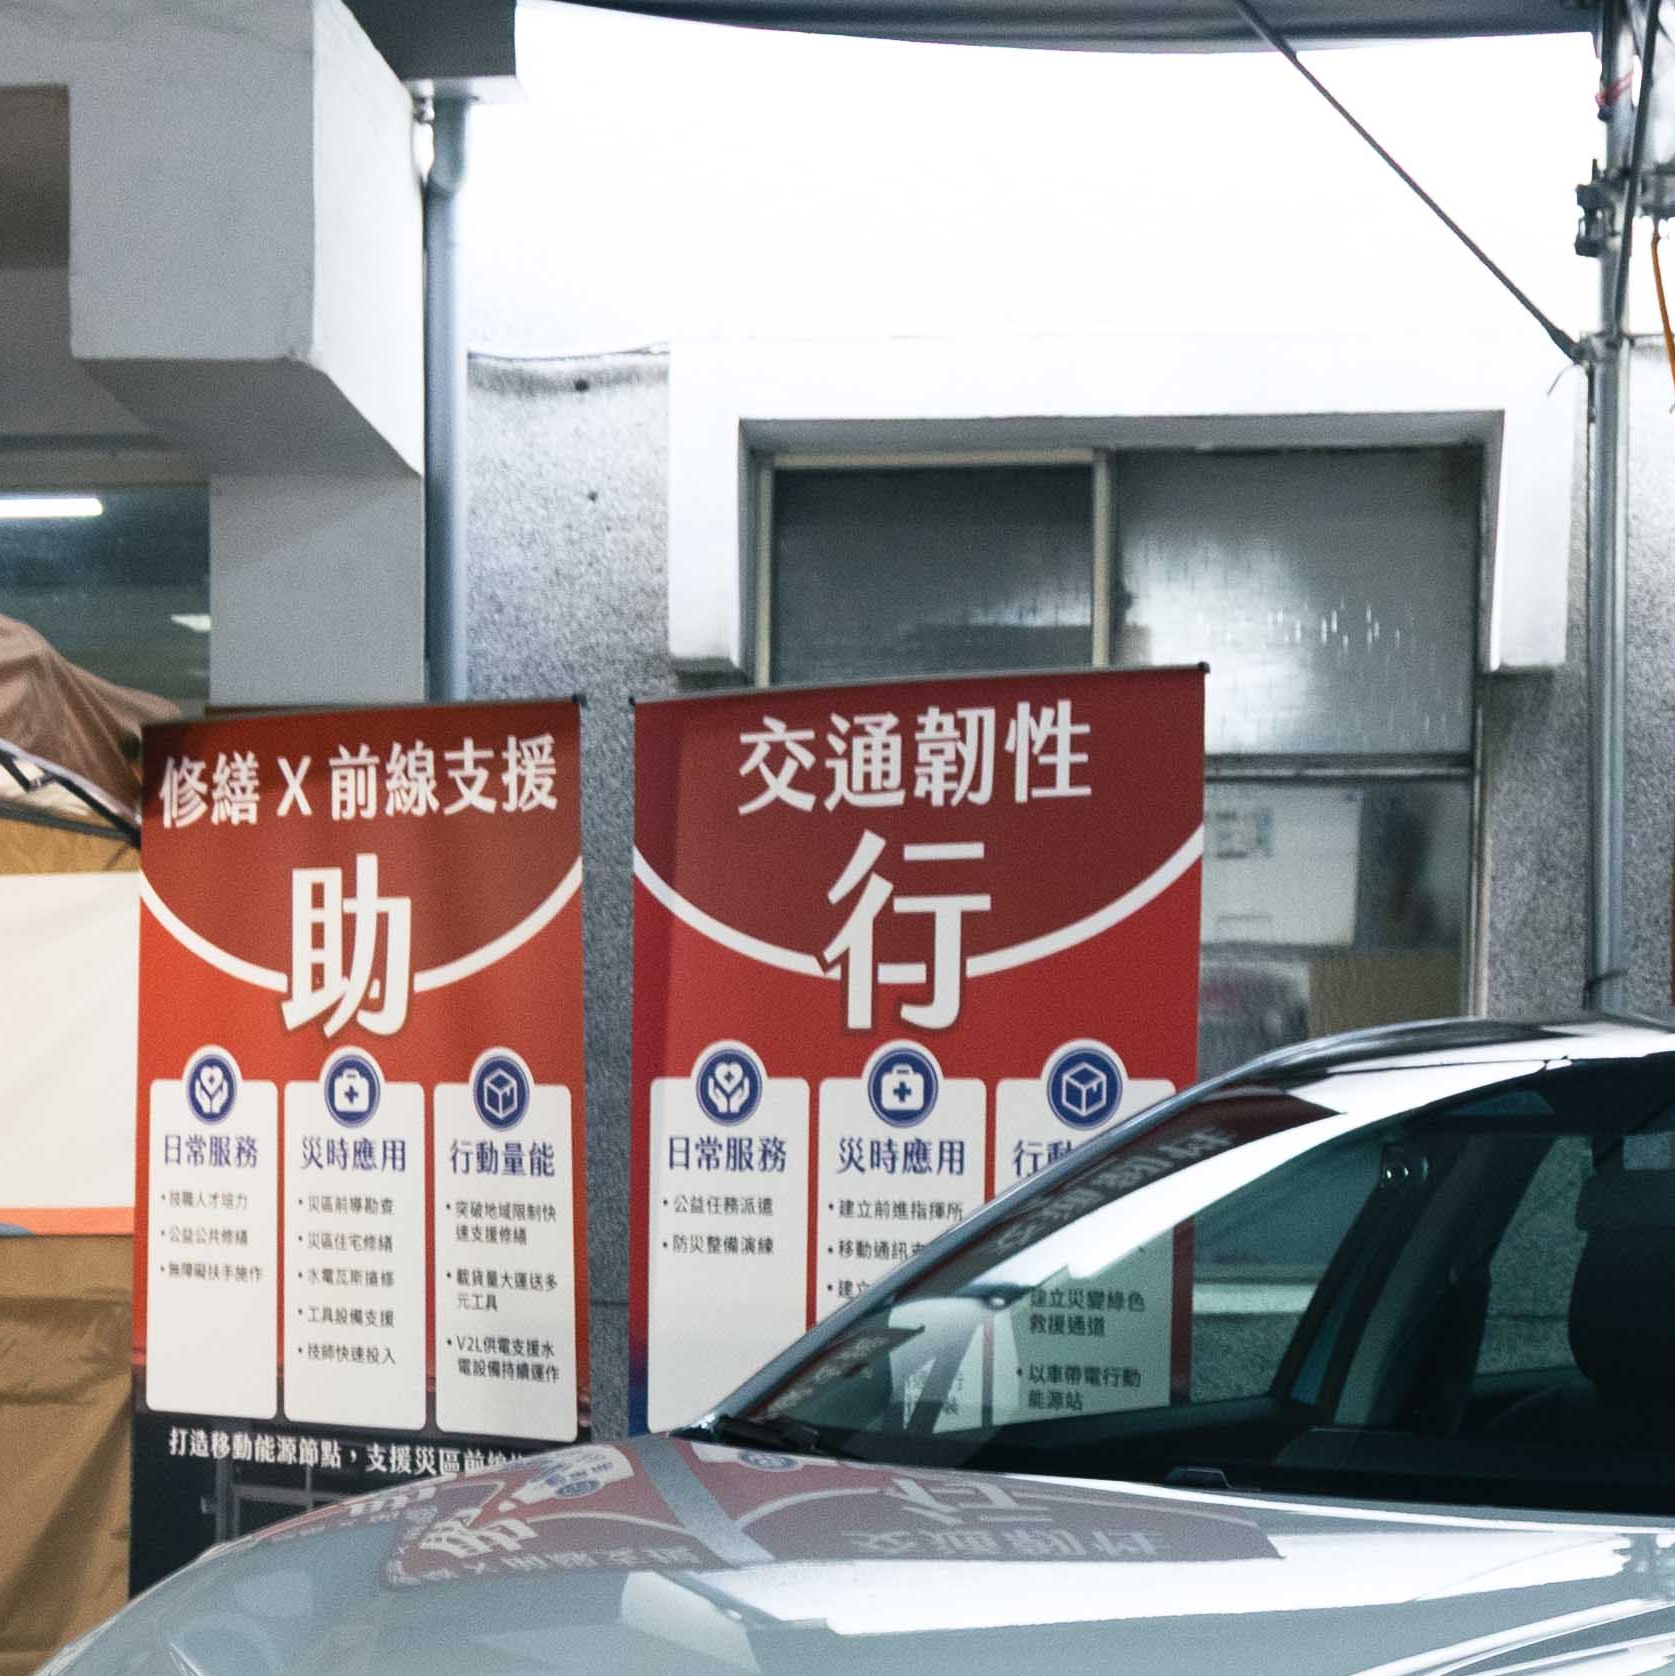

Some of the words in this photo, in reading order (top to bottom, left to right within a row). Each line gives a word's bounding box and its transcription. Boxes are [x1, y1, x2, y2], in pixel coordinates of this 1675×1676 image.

[738, 699, 1092, 815] 交通韌性
[160, 751, 260, 828] 修繕
[277, 755, 313, 817] X
[329, 734, 558, 821] 前線支援
[824, 829, 991, 1030] 行
[281, 853, 411, 1037] 助
[164, 1133, 258, 1168] 日常服務
[301, 1136, 406, 1172] 災時應用
[449, 1138, 555, 1177] 行動量能
[669, 1136, 787, 1172] 日常服務
[836, 1136, 965, 1175] 災時應用
[455, 1201, 556, 1223] 突破地域限制快
[674, 1195, 774, 1216] 公益任務派遣
[839, 1200, 964, 1222] 建立前進指揮所
[456, 1225, 527, 1246] 速支援修繕
[673, 1234, 774, 1255] 防災整備演練
[456, 1268, 558, 1292] 載貨量大運送多
[457, 1293, 498, 1312] 元工具
[308, 1305, 395, 1329] 工具設備支援
[456, 1335, 555, 1359] V2L供電支援水
[458, 1358, 560, 1384] 電設備持續運作
